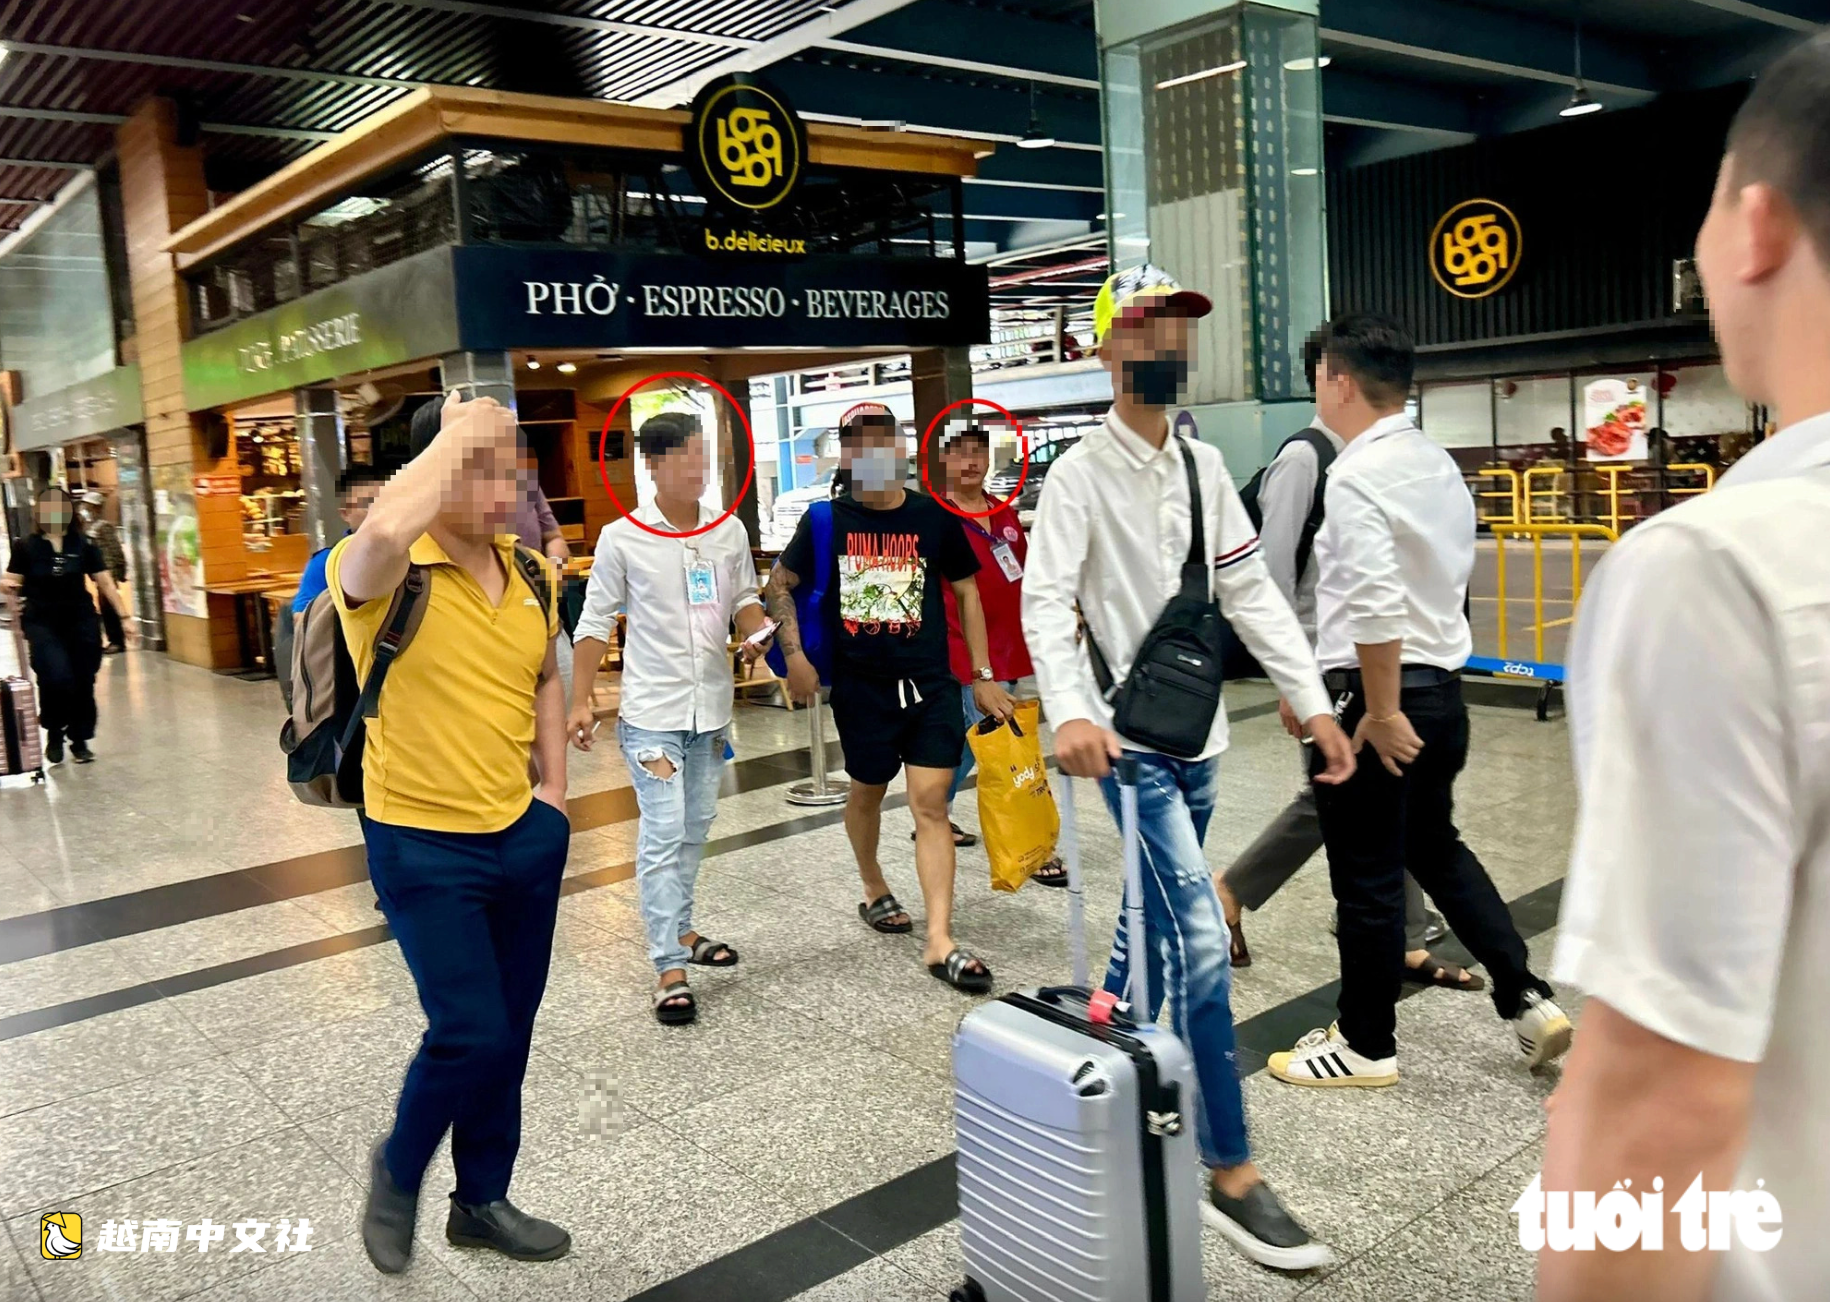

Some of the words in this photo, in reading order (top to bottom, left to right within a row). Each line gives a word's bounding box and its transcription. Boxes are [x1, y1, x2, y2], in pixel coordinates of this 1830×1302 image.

[523, 274, 620, 316] PHỞ
[641, 285, 786, 317] ESPRESSO
[804, 289, 950, 319] BEVERAGES
[846, 532, 880, 572] PUMA
[881, 533, 920, 573] HOOPS
[1013, 766, 1035, 788] yody
